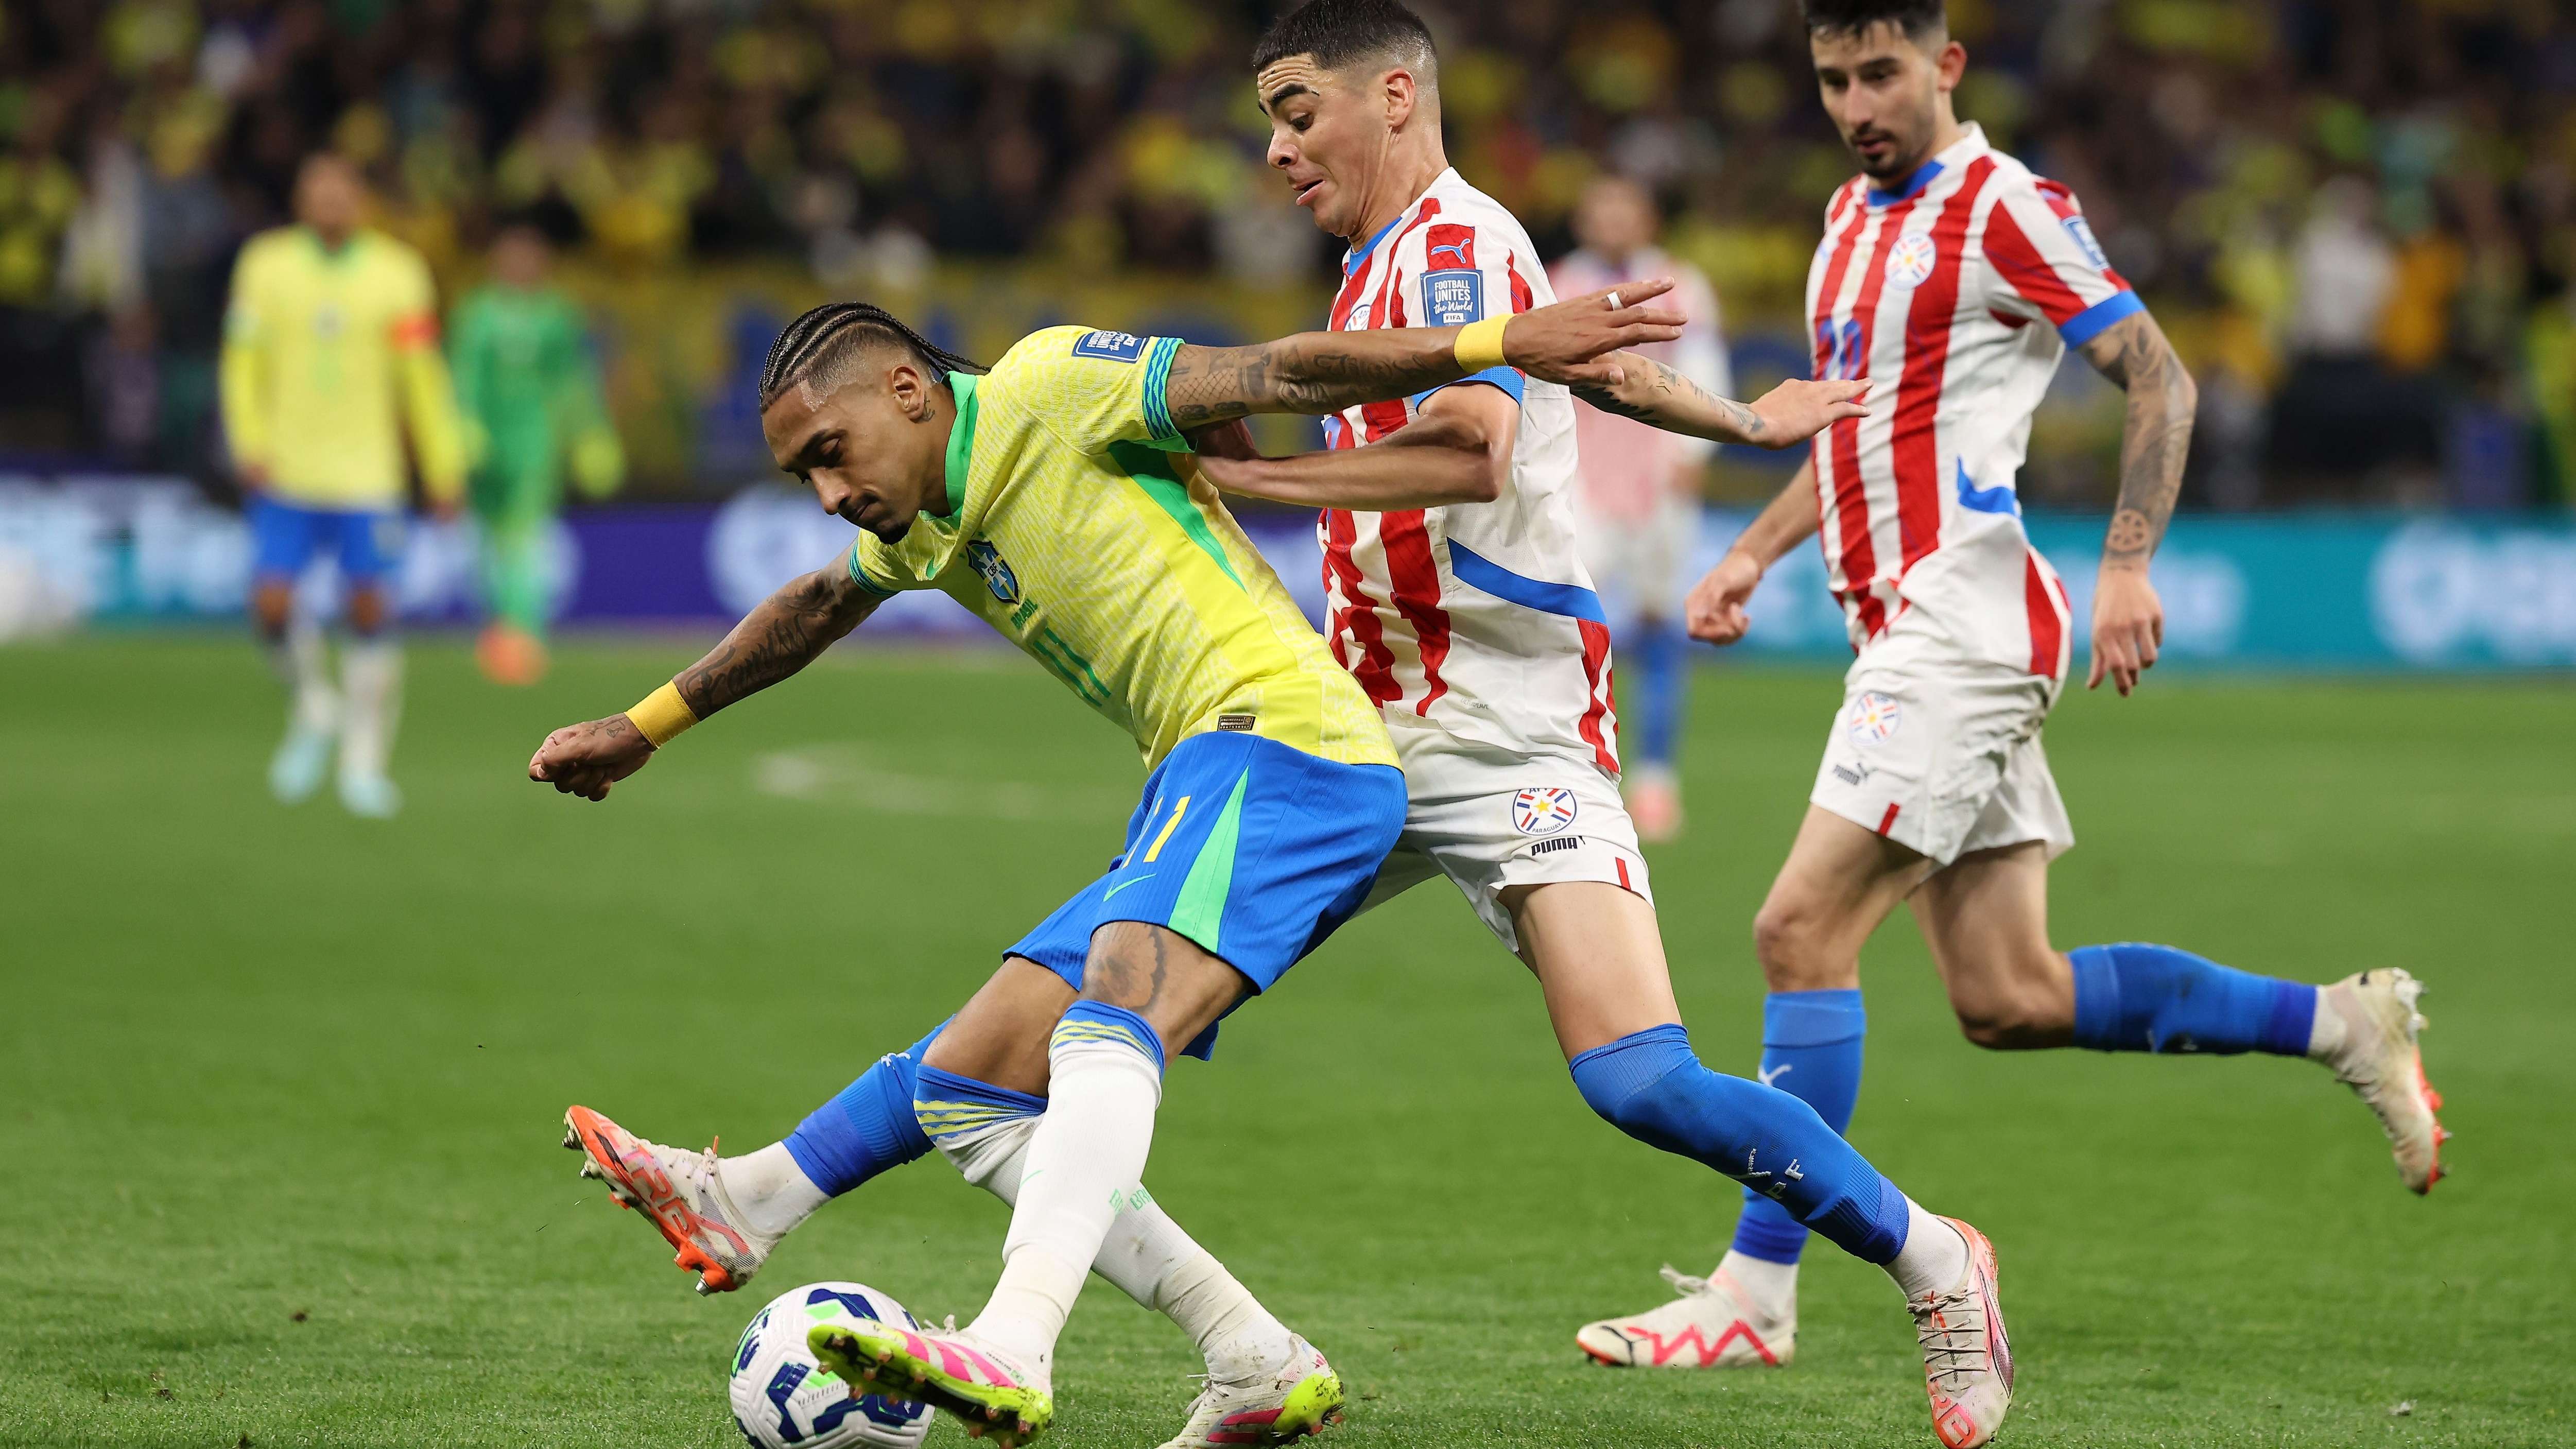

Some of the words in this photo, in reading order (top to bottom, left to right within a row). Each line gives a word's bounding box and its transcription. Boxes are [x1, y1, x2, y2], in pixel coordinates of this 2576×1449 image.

[1434, 280, 1471, 291] FOOTBALL
[1434, 289, 1471, 303] UNITES
[1433, 302, 1447, 315] the
[1448, 300, 1474, 313] World
[987, 562, 998, 577] CBF
[1032, 625, 1112, 708] 11
[1120, 795, 1191, 870] 11
[1531, 822, 1562, 833] PARAGUAY
[1531, 837, 1578, 856] PUMA
